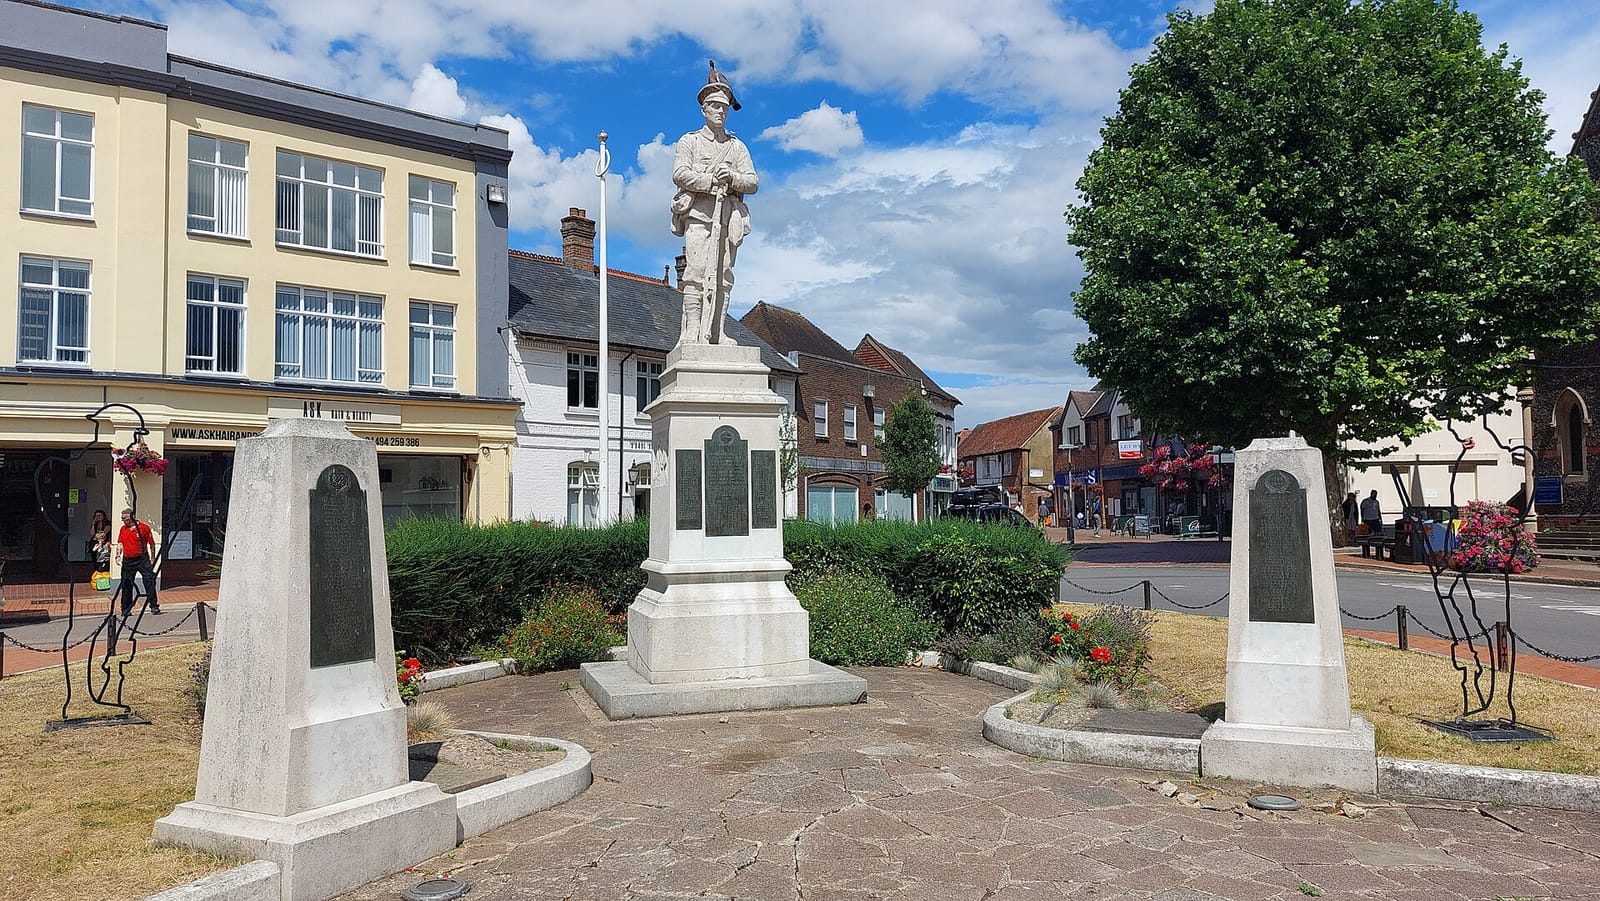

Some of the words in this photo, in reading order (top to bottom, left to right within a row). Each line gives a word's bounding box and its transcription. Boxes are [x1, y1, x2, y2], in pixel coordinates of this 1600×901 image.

[303, 401, 322, 418] ASK
[331, 410, 344, 420] HAIR
[346, 411, 351, 420] &
[352, 411, 372, 421] BEAUTY
[171, 428, 260, 441] WWW.ASKHAIRAND
[364, 436, 389, 446] 494
[390, 437, 405, 447] 259
